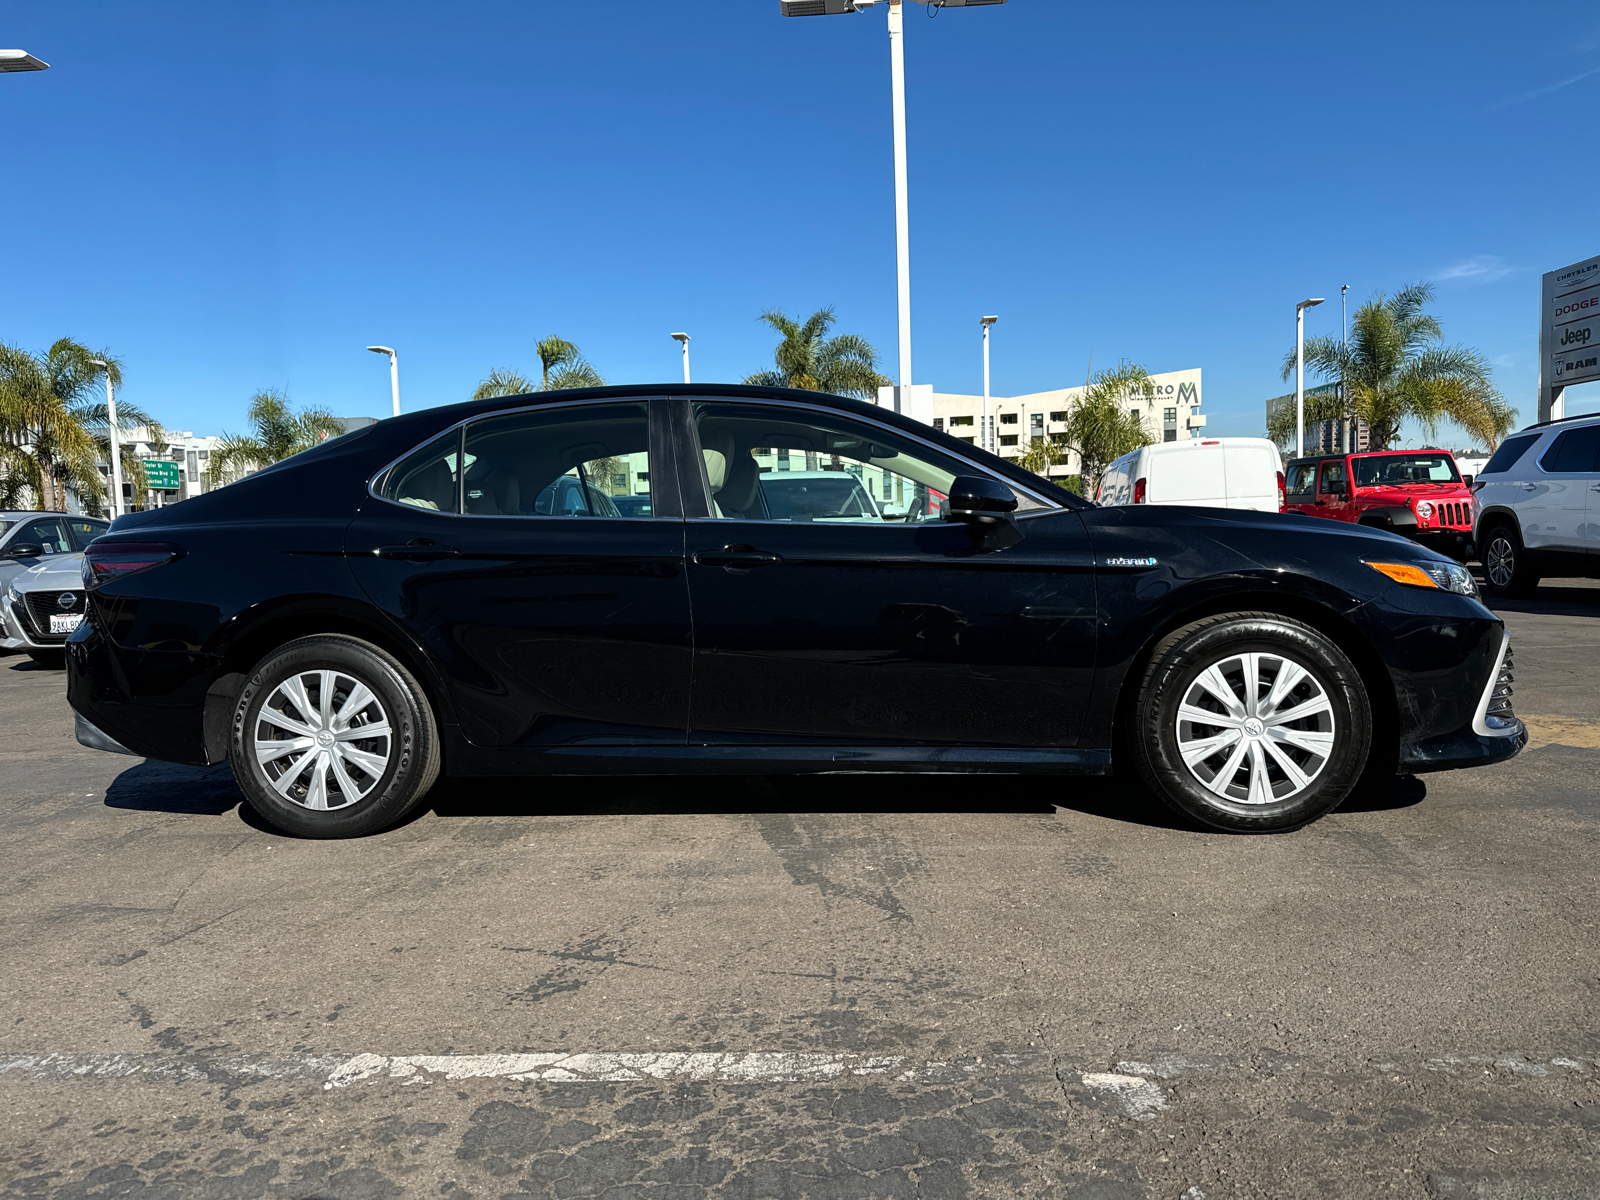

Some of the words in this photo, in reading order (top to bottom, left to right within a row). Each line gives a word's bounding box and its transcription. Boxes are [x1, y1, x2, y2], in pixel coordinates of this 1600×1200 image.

[1556, 264, 1599, 282] CHRYSLER
[1555, 296, 1600, 317] DODGE
[1560, 327, 1592, 346] Jeep
[1565, 357, 1598, 371] RAM
[1107, 558, 1150, 566] HYBRID
[51, 620, 81, 631] 9AKL80
